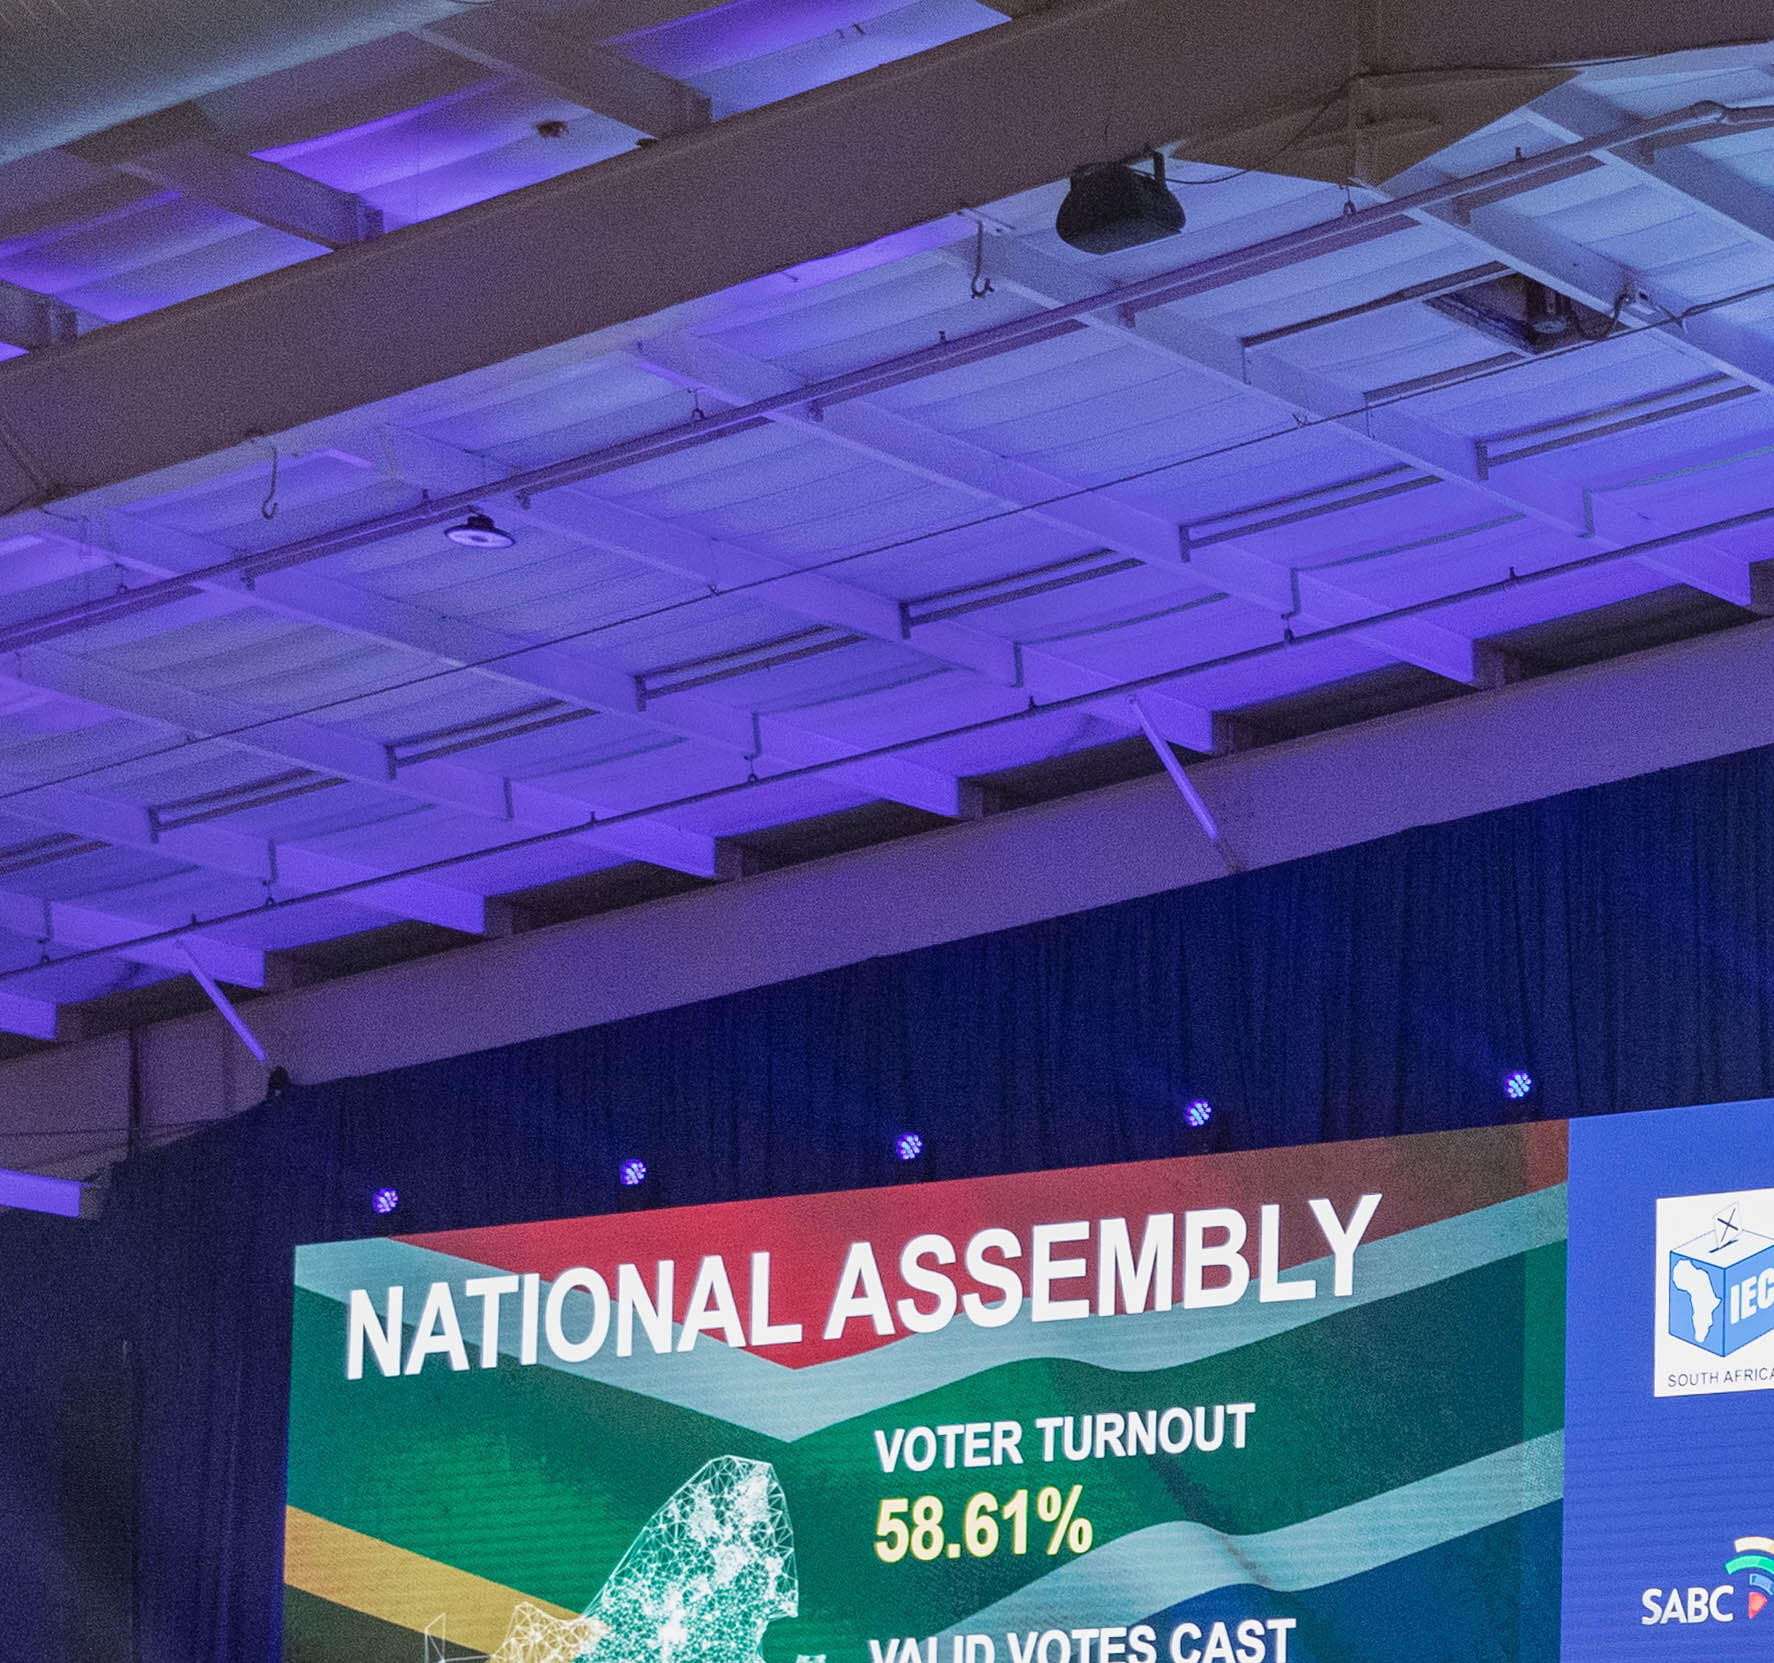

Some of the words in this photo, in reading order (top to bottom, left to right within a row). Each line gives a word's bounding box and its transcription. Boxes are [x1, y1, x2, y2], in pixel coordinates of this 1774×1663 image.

[348, 1252, 802, 1379] NATIONAL
[824, 1194, 1382, 1339] ASSEMBLY
[1668, 1372, 1719, 1387] SOUTH
[874, 1421, 1023, 1472] VOTER
[1036, 1402, 1256, 1461] TURNOUT
[875, 1485, 1092, 1562] 58.61%
[1642, 1585, 1733, 1624] SABC
